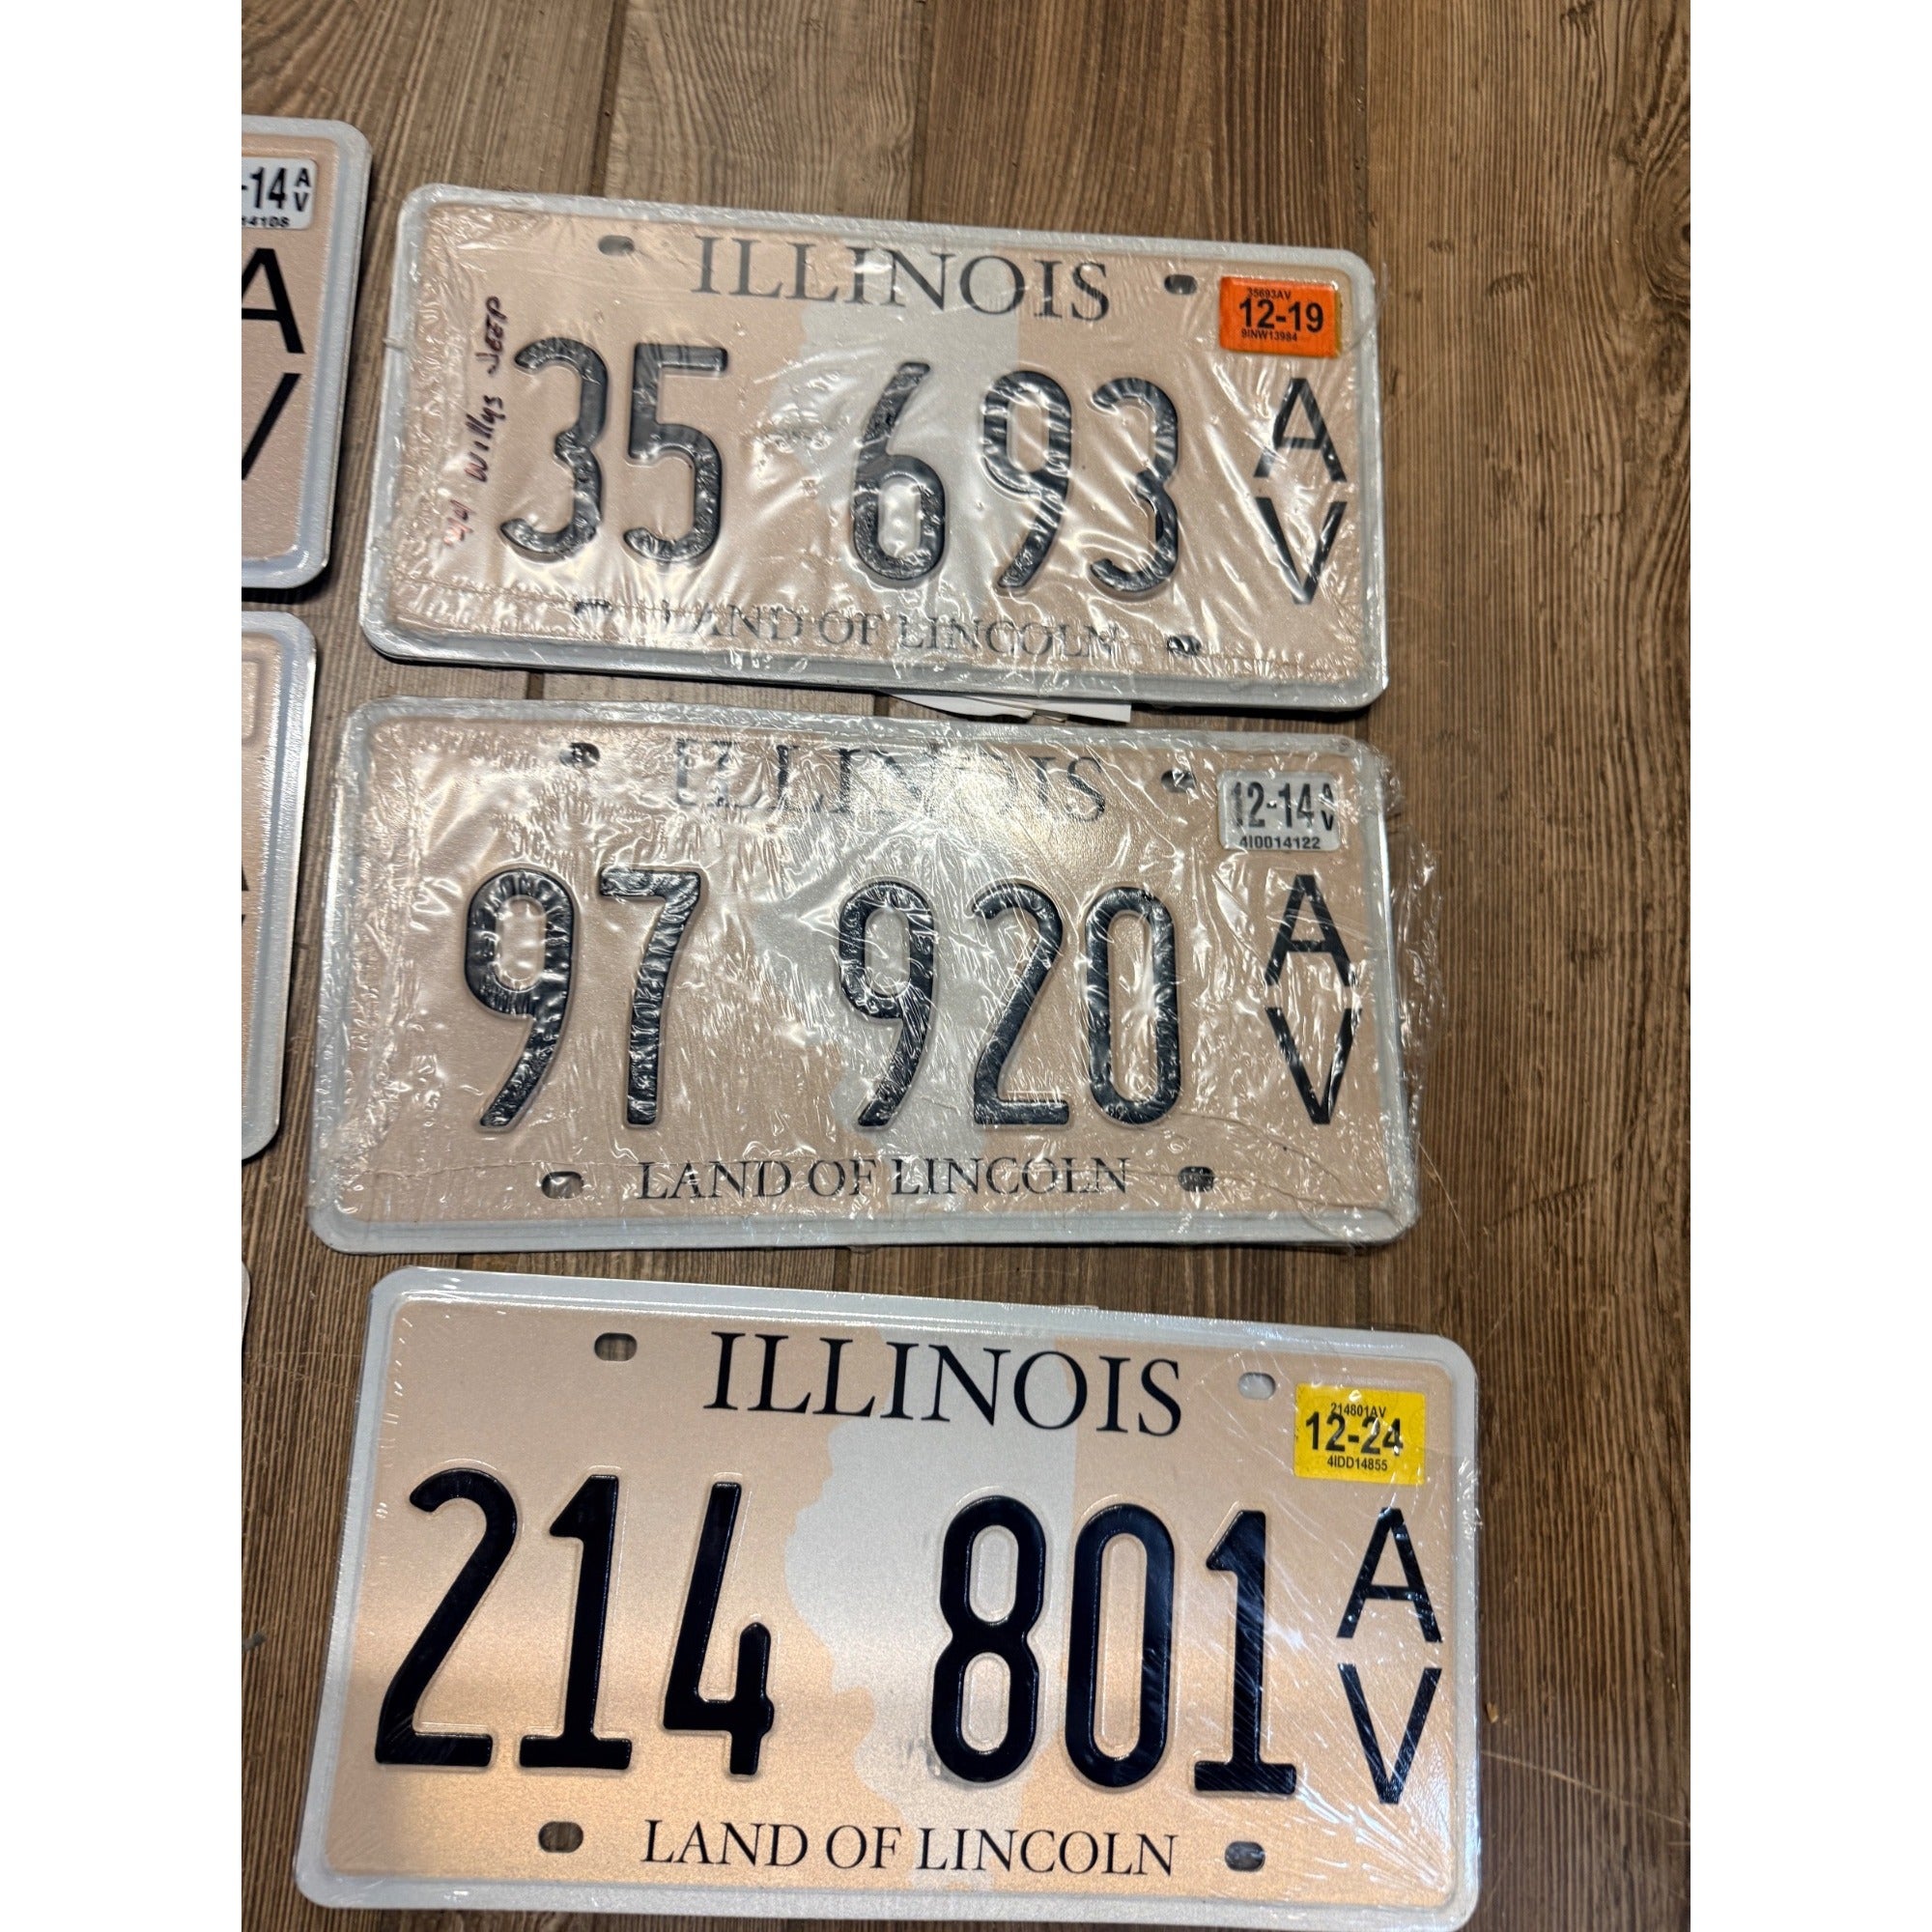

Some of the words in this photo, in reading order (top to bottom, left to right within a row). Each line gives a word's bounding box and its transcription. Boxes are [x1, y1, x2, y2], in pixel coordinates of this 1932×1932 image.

[691, 235, 1111, 322] ILLINOIS
[1238, 298, 1324, 333] 12-19
[500, 336, 728, 564] 35
[851, 361, 1179, 594] 693
[820, 610, 883, 645] OF
[1232, 781, 1315, 829] 12-14
[465, 868, 703, 1128] 97
[838, 880, 1181, 1128] 920
[637, 1159, 793, 1200] LAND
[809, 1158, 878, 1198] OF
[890, 1156, 1130, 1196] LINCOLN
[703, 1330, 1182, 1437] ILLINOIS
[1331, 1402, 1386, 1418] 214801AV
[1305, 1410, 1404, 1457] 12-24
[376, 1466, 774, 1776] 214
[930, 1494, 1297, 1795] 801
[641, 1818, 810, 1868] LAND
[825, 1824, 902, 1870] OF
[915, 1827, 1179, 1876] LINCOLN
